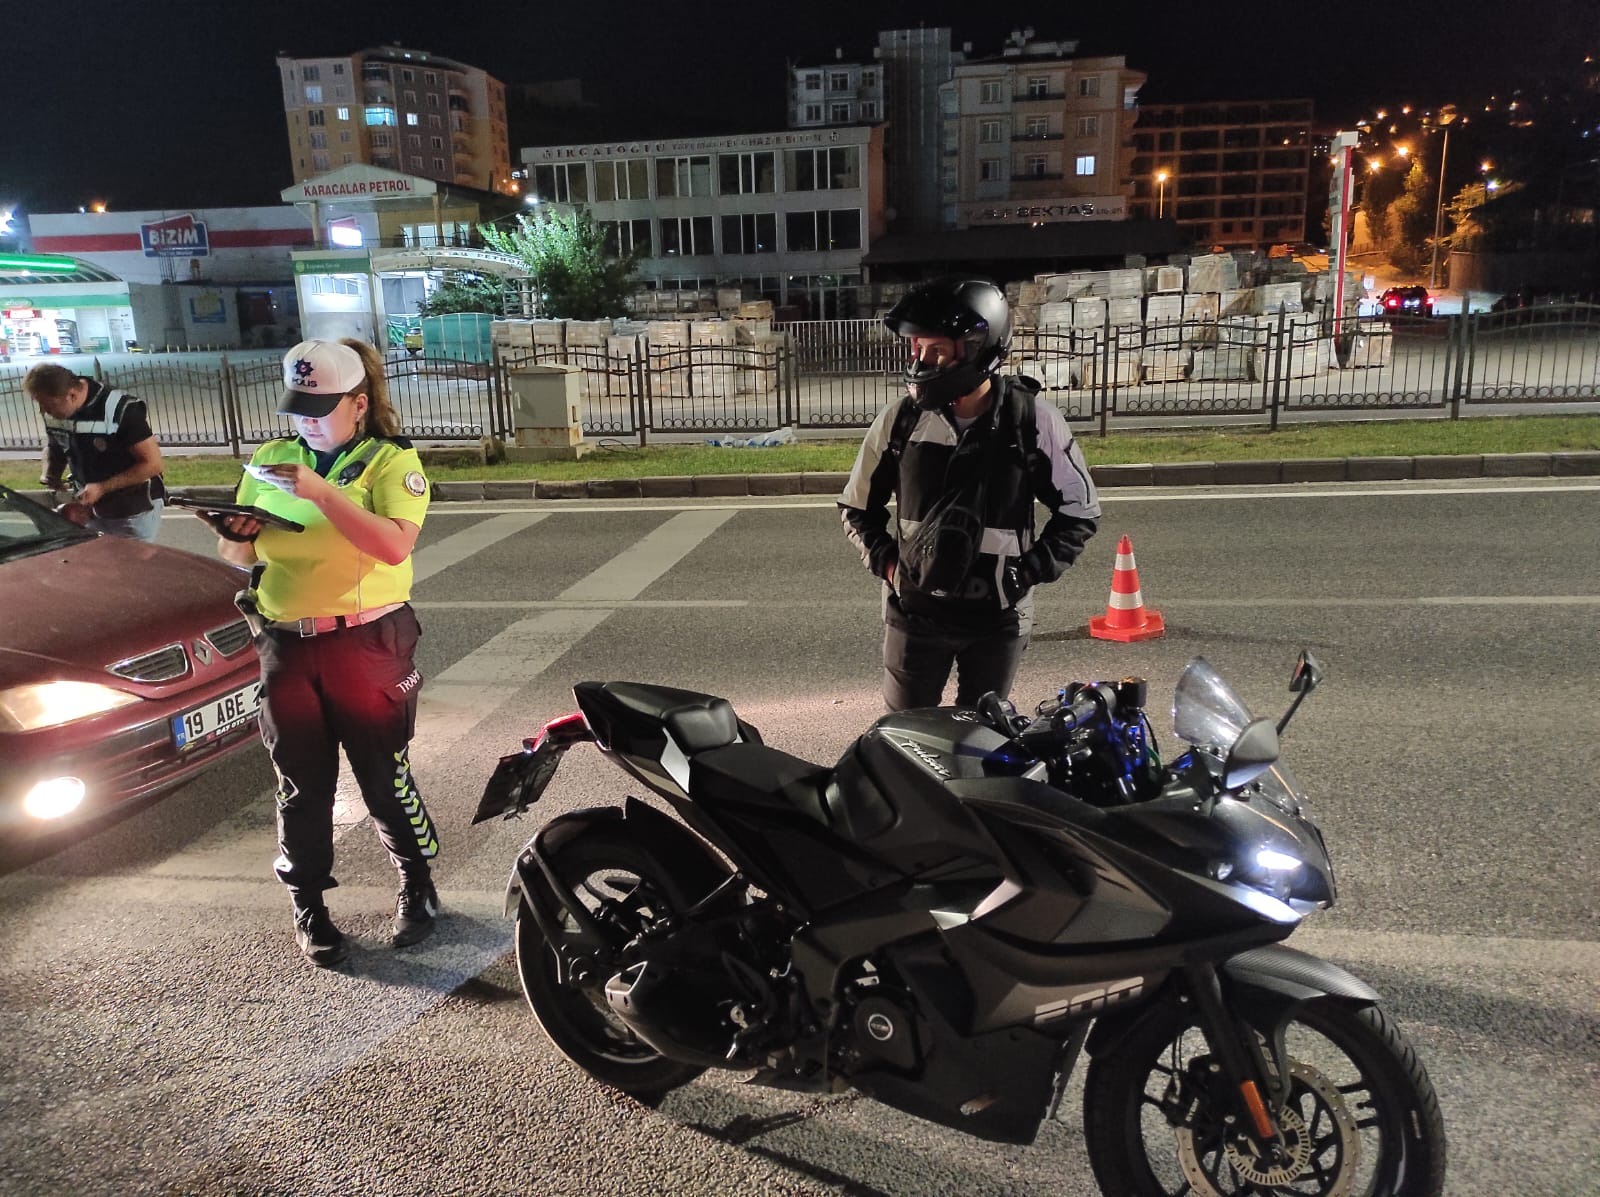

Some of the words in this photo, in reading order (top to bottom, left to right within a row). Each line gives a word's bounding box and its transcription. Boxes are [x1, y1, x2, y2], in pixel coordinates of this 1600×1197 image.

[304, 182, 367, 197] KARACALAR
[369, 179, 411, 193] PETROL
[185, 711, 204, 738] 19
[217, 692, 246, 726] ABE
